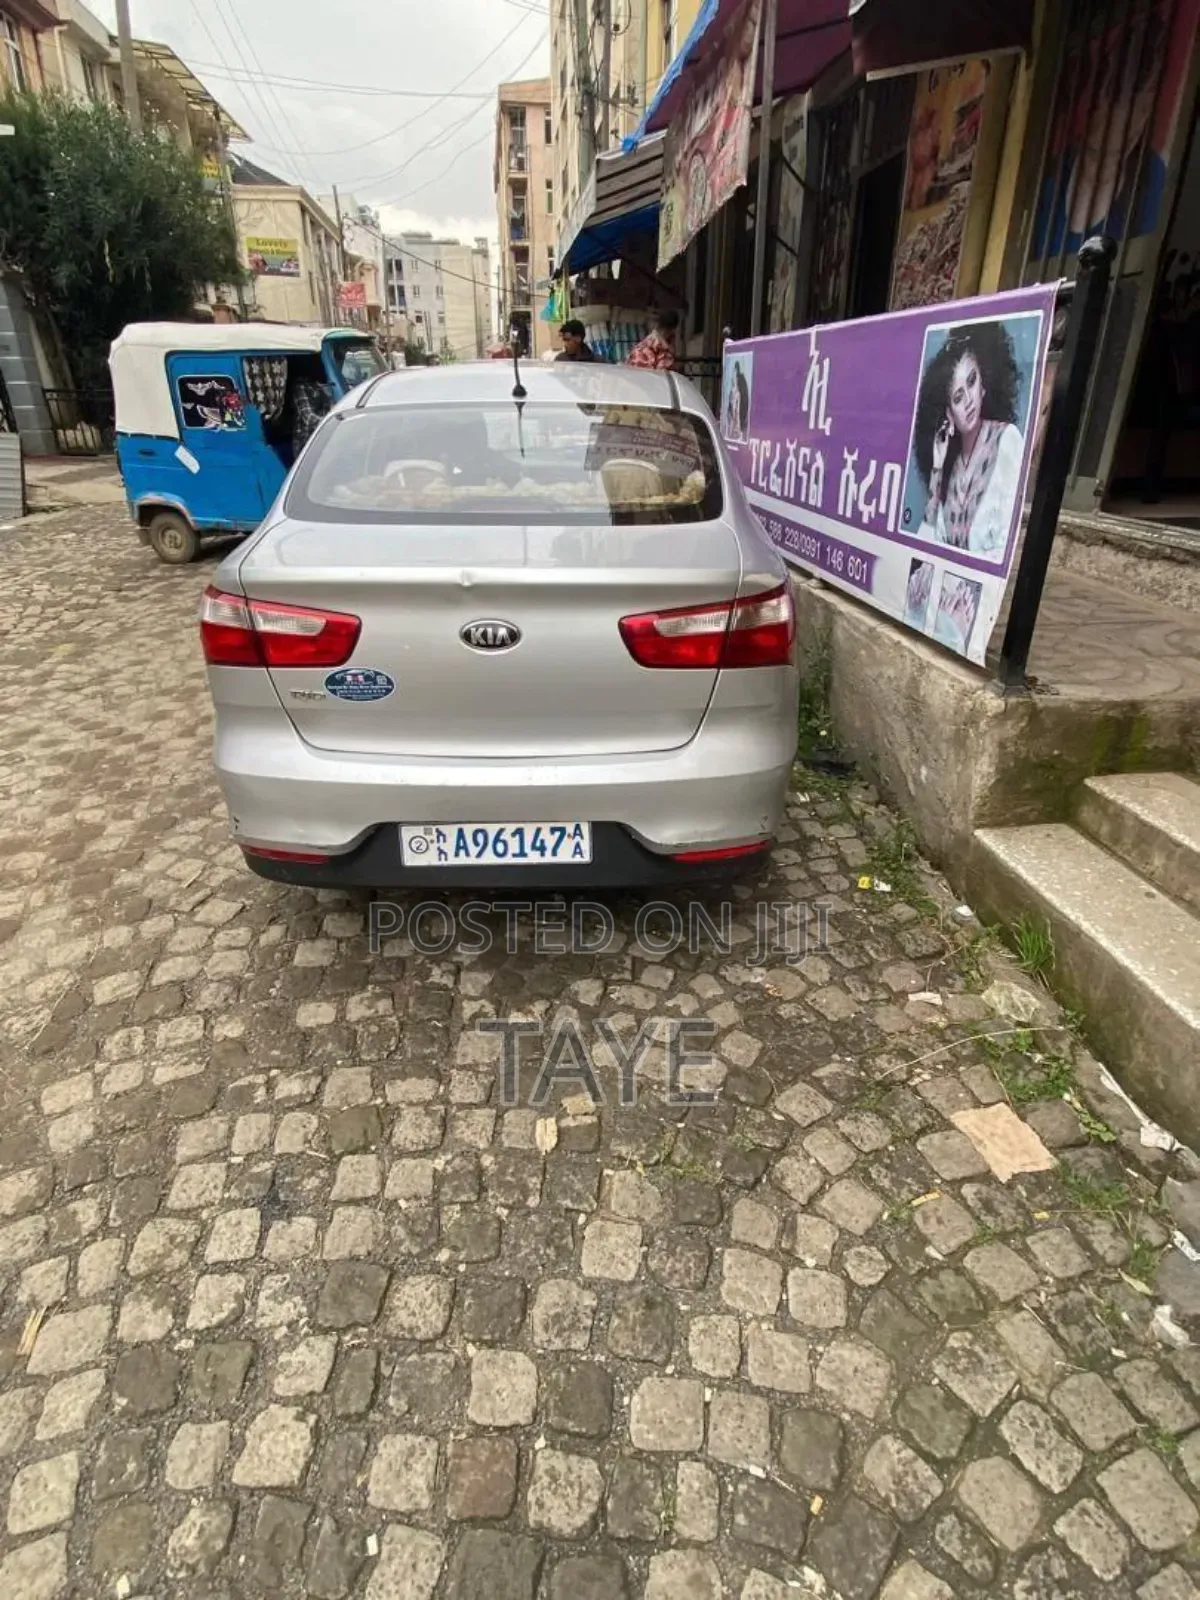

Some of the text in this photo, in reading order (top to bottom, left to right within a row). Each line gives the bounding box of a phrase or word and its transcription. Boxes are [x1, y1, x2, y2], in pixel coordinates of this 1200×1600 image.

[837, 445, 902, 533] ሹሩባ
[826, 545, 844, 572] 146
[847, 555, 868, 584] 601
[470, 627, 511, 645] KIA
[454, 826, 567, 859] A96147
